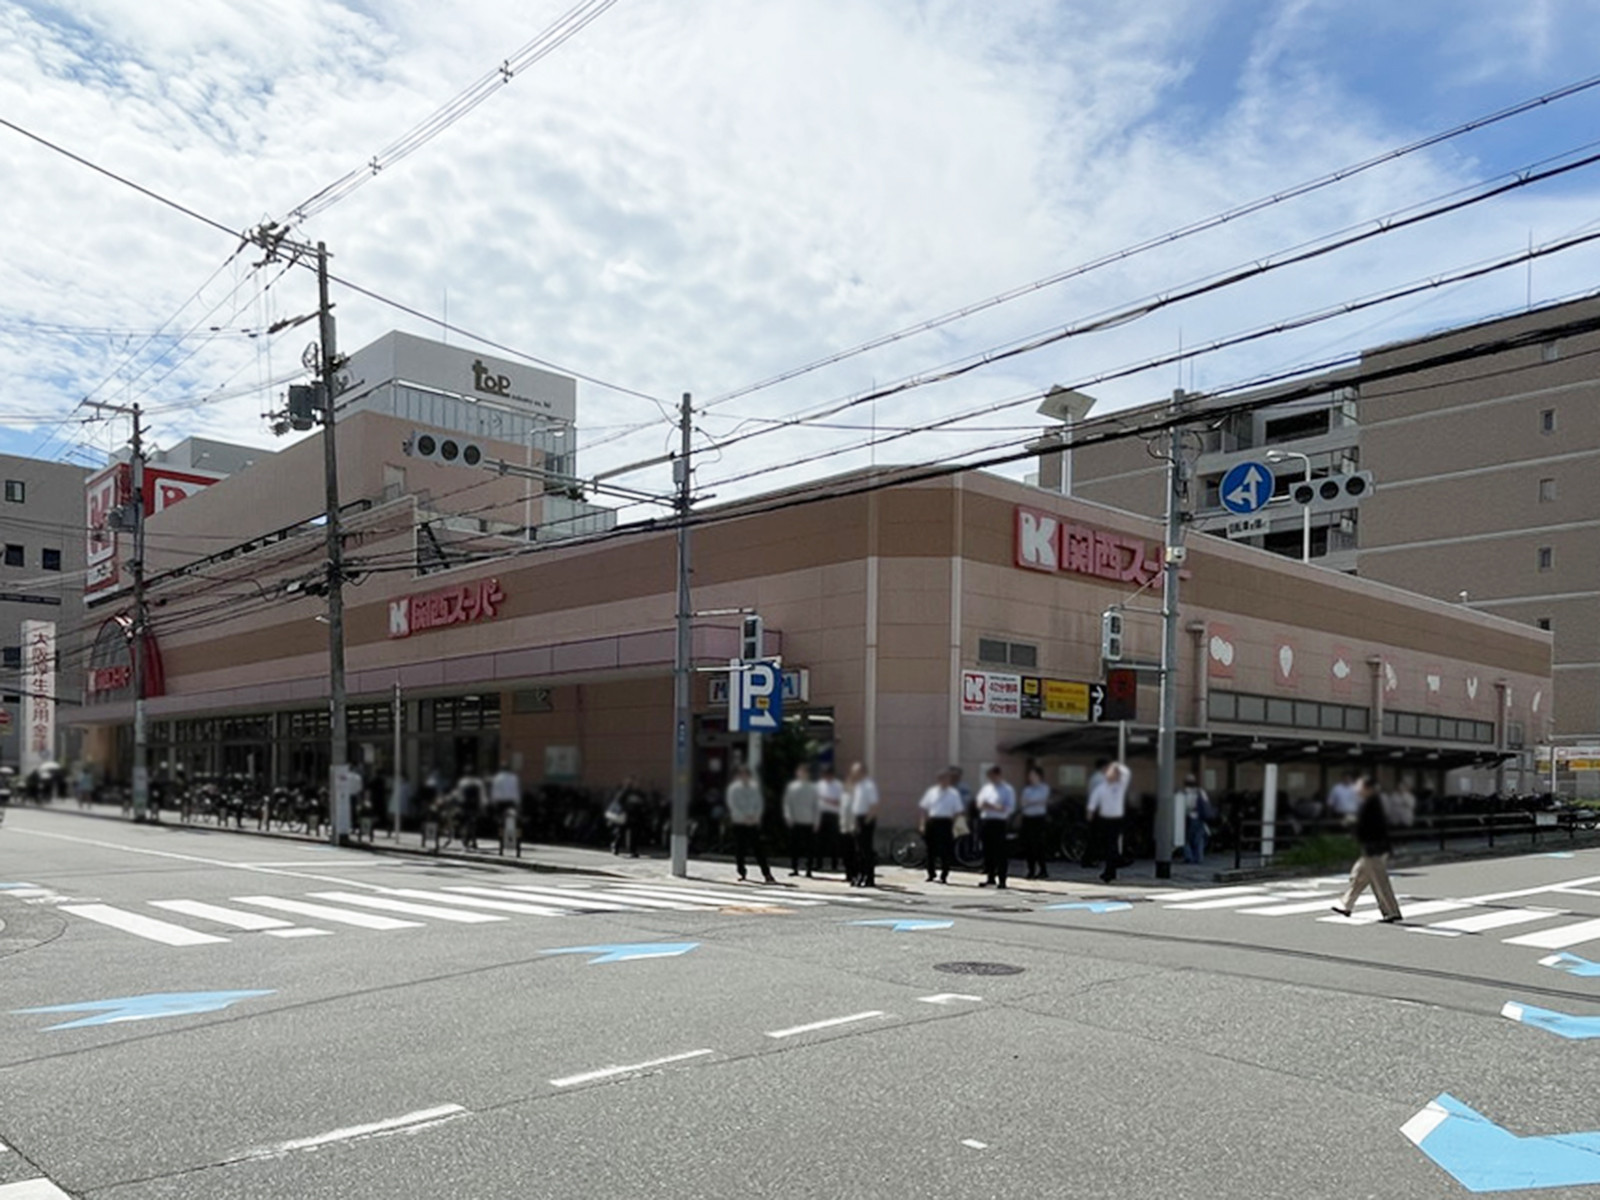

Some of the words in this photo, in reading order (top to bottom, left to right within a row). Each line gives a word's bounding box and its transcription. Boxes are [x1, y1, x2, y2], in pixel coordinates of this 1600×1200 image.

[1019, 511, 1057, 568] K
[389, 599, 410, 635] K
[411, 580, 504, 630] 関西スーパー
[742, 664, 775, 709] P
[964, 675, 985, 703] K
[1092, 704, 1103, 723] P
